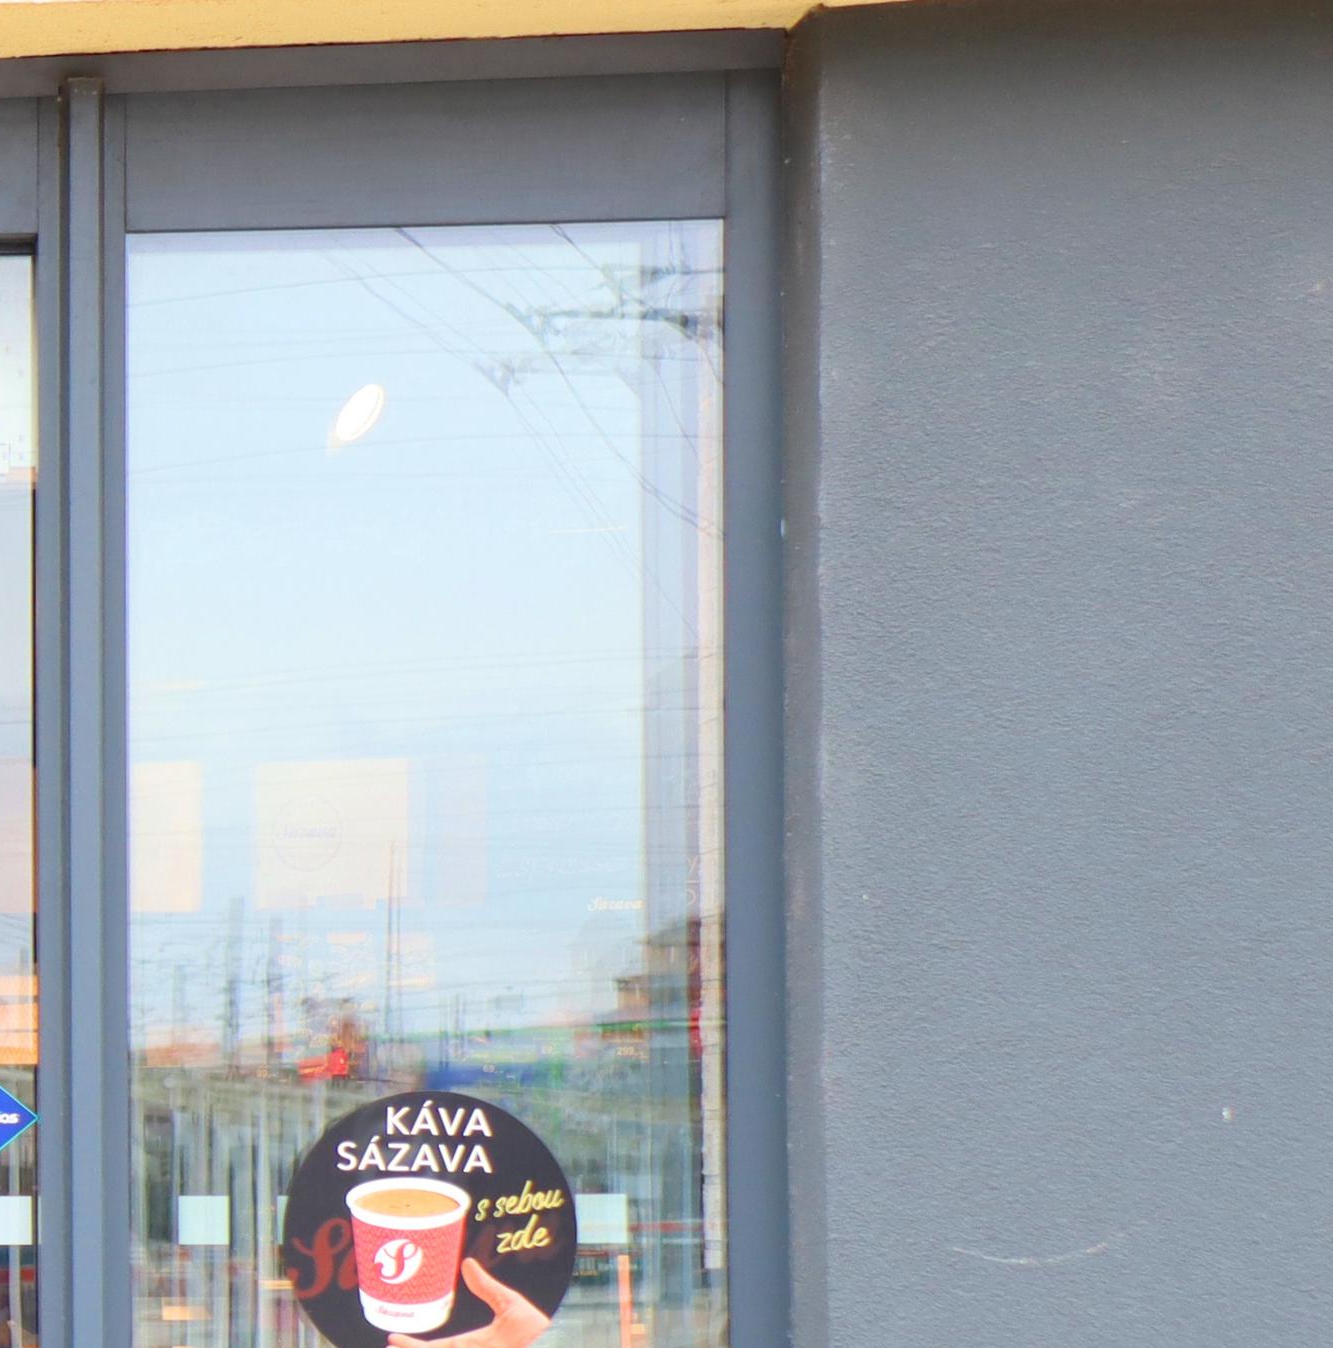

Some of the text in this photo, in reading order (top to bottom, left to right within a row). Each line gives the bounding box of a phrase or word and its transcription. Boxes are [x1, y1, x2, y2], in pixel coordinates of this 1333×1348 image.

[386, 1100, 493, 1137] KÁVA
[336, 1136, 493, 1173] SÁZAVA
[474, 1180, 564, 1222] s sebou
[496, 1215, 552, 1254] zde
